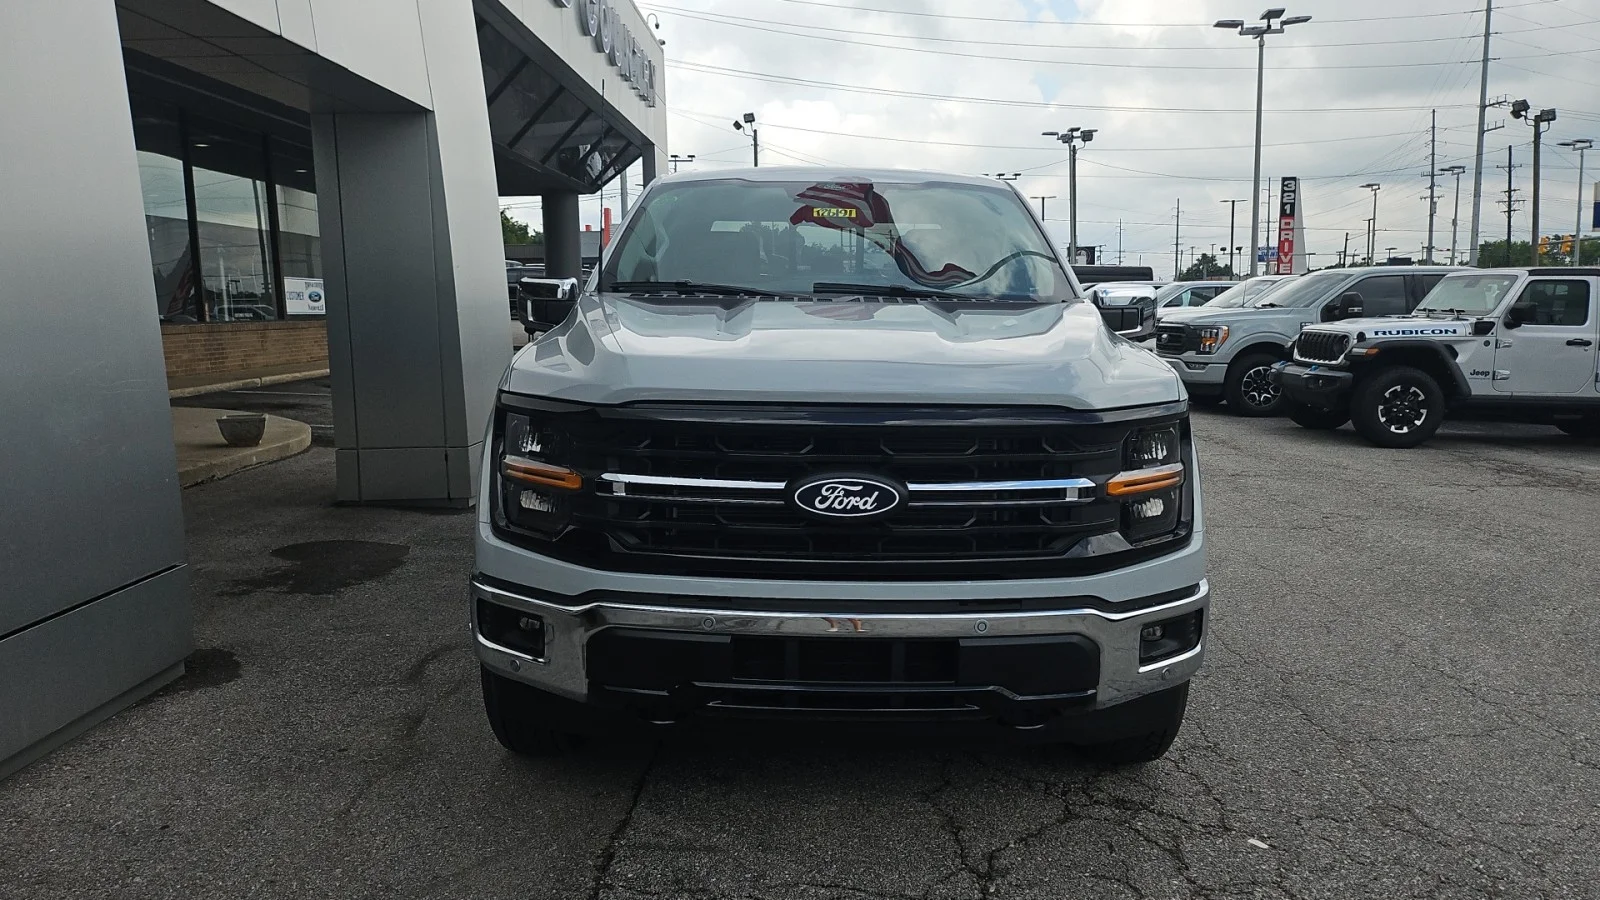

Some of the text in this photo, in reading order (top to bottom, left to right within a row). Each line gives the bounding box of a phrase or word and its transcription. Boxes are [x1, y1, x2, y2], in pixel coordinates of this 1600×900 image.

[1283, 181, 1296, 214] 321
[1279, 219, 1294, 274] DRIVE
[1470, 369, 1490, 377] Jeep
[814, 484, 879, 510] Ford
